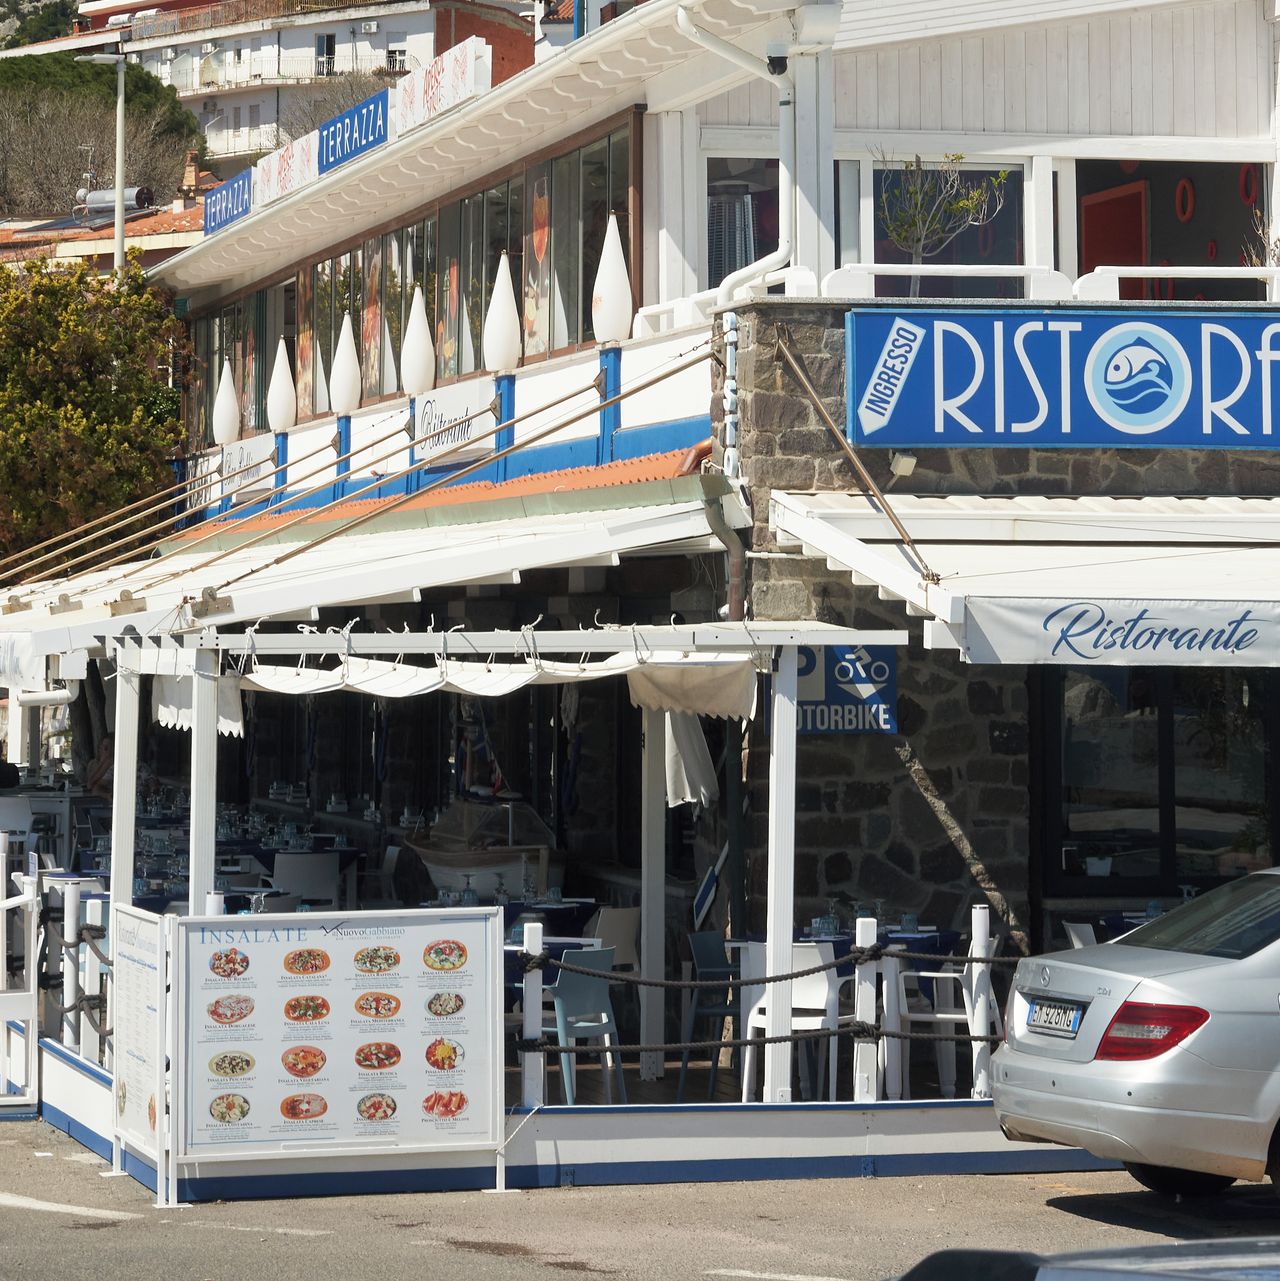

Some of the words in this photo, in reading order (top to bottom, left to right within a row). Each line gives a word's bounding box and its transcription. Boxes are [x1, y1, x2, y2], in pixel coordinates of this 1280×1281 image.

[322, 100, 386, 166] TERRAZZA
[206, 177, 251, 229] TERRAZZA
[865, 326, 918, 417] INGRESSO
[1043, 602, 1272, 660] Ristorante
[797, 704, 891, 731] TORBIKE
[200, 926, 309, 945] INSALATE
[1044, 1004, 1074, 1028] 928MG
